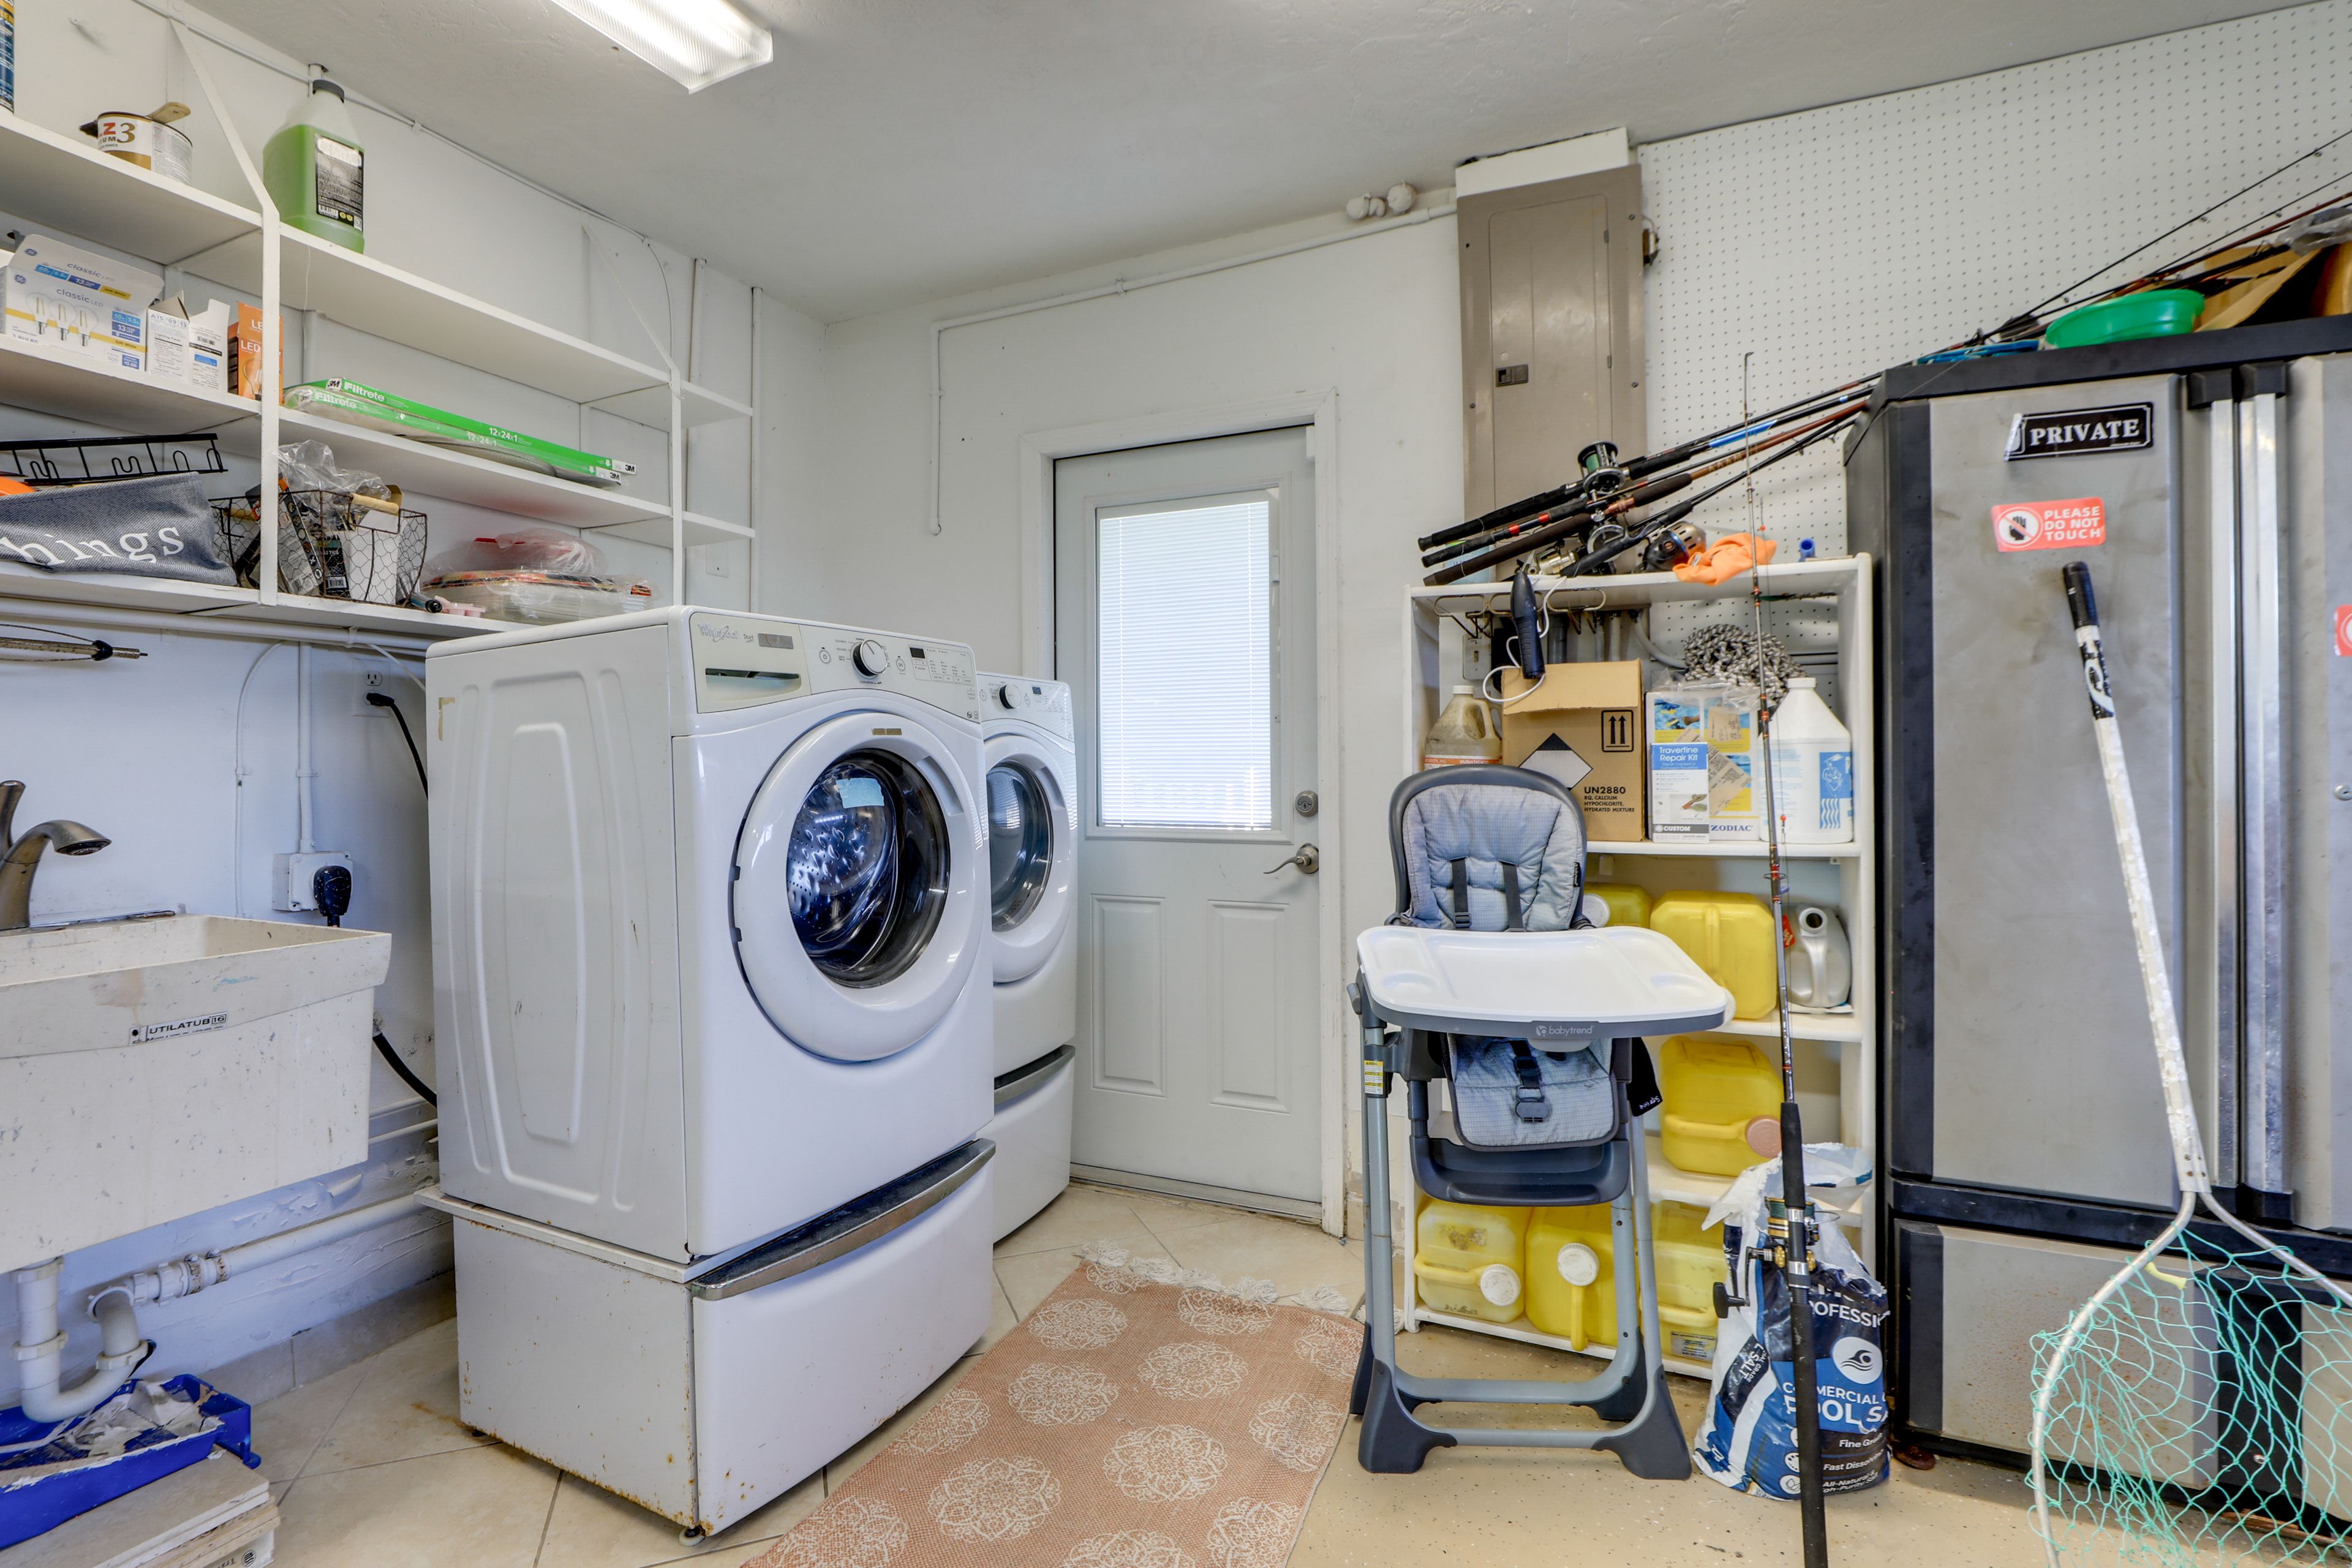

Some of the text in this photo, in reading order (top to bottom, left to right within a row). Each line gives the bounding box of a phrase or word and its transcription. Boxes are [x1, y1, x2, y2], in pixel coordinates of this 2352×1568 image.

[117, 123, 135, 143] 3
[67, 263, 101, 277] classic
[56, 288, 90, 303] classic
[252, 319, 263, 331] LE
[241, 340, 261, 353] LED
[344, 381, 385, 402] Filtrete
[314, 392, 357, 409] Filtrete
[489, 427, 518, 442] 12x24x1
[2029, 418, 2140, 447] PRIVATE
[625, 464, 635, 473] 3M
[610, 472, 620, 480] 3M
[2044, 506, 2101, 520] PLEASE
[2045, 518, 2100, 530] DO NOT
[2044, 528, 2101, 542] TOUCH
[1660, 754, 1687, 763] Repair
[149, 1018, 210, 1035] UTILATUB
[1549, 1025, 1593, 1036] babytrend
[1809, 1300, 1891, 1328] OFESSI
[1738, 1351, 1760, 1379] SALT
[1746, 1363, 1762, 1383] GRADE
[1839, 1439, 1861, 1448] Fine
[1822, 1481, 1866, 1493] gh-Purity
